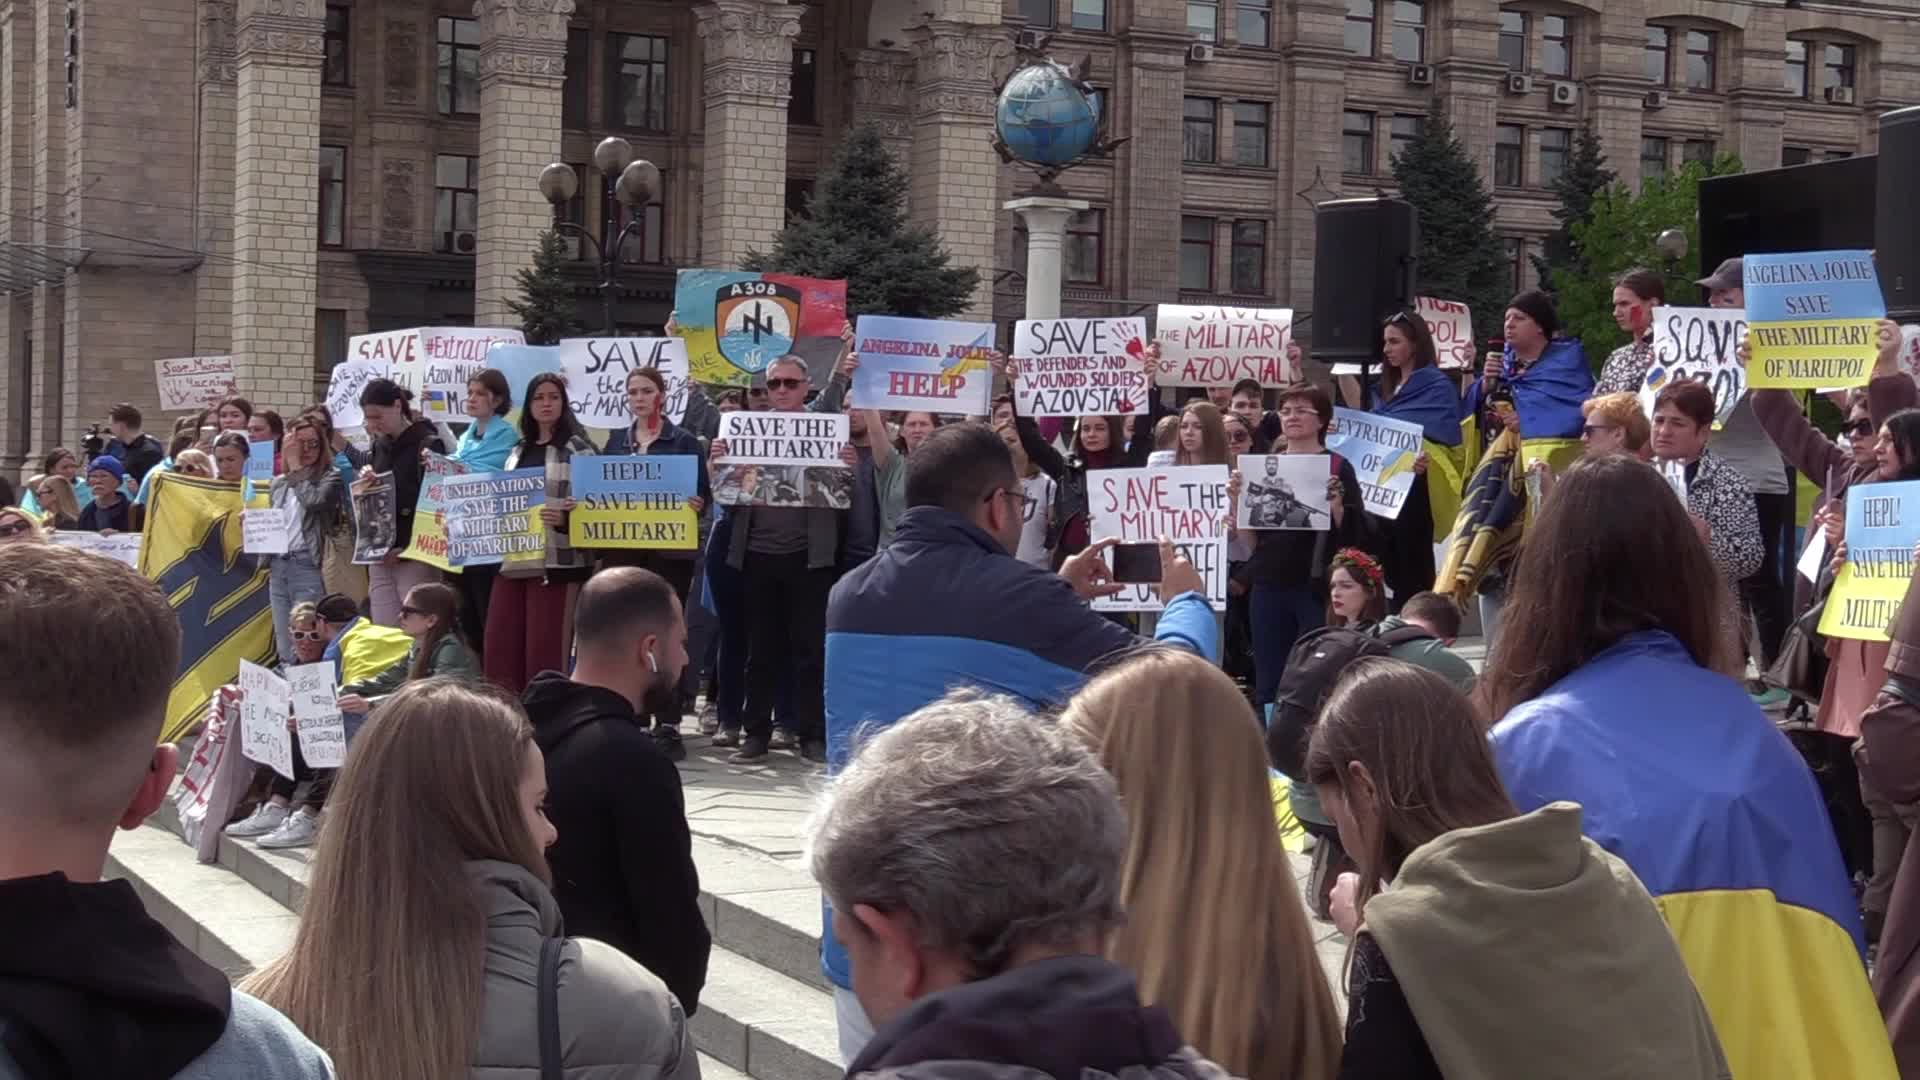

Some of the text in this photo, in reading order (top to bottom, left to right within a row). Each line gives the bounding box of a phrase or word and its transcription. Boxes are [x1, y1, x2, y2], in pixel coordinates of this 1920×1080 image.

[1822, 260, 1872, 281] JOLIE
[1785, 295, 1831, 315] SAVE
[1030, 320, 1107, 355] SAVE
[1160, 322, 1290, 351] THE MILITARY
[1753, 325, 1871, 347] THE MILITARY
[358, 335, 420, 364] SAVE
[585, 339, 673, 374] SAVE
[859, 338, 941, 358] ANGELINA
[1018, 355, 1128, 373] THE DEFENDERS AND
[1160, 355, 1289, 385] OF AZOVSTAL
[1764, 358, 1865, 378] OF MARIUPOL
[596, 375, 626, 396] the
[888, 371, 966, 399] HELP
[1024, 370, 1146, 390] WOUNDED SOLDIERS
[569, 393, 593, 416] of
[728, 416, 837, 439] SAVE THE
[602, 462, 664, 481] HEPL!
[1361, 453, 1382, 472] OF
[446, 481, 490, 499] UNITED
[584, 491, 684, 511] SAVE THE
[1103, 476, 1227, 513] SAVE THE
[463, 495, 530, 518] SAVE THE
[1863, 498, 1901, 528] HEPL!
[463, 515, 530, 538] MILITARY
[581, 521, 687, 541] MILITARY!
[1120, 509, 1218, 541] MILITARY
[451, 534, 545, 559] OF MARIUPOL
[1852, 549, 1914, 579] SAVE THE
